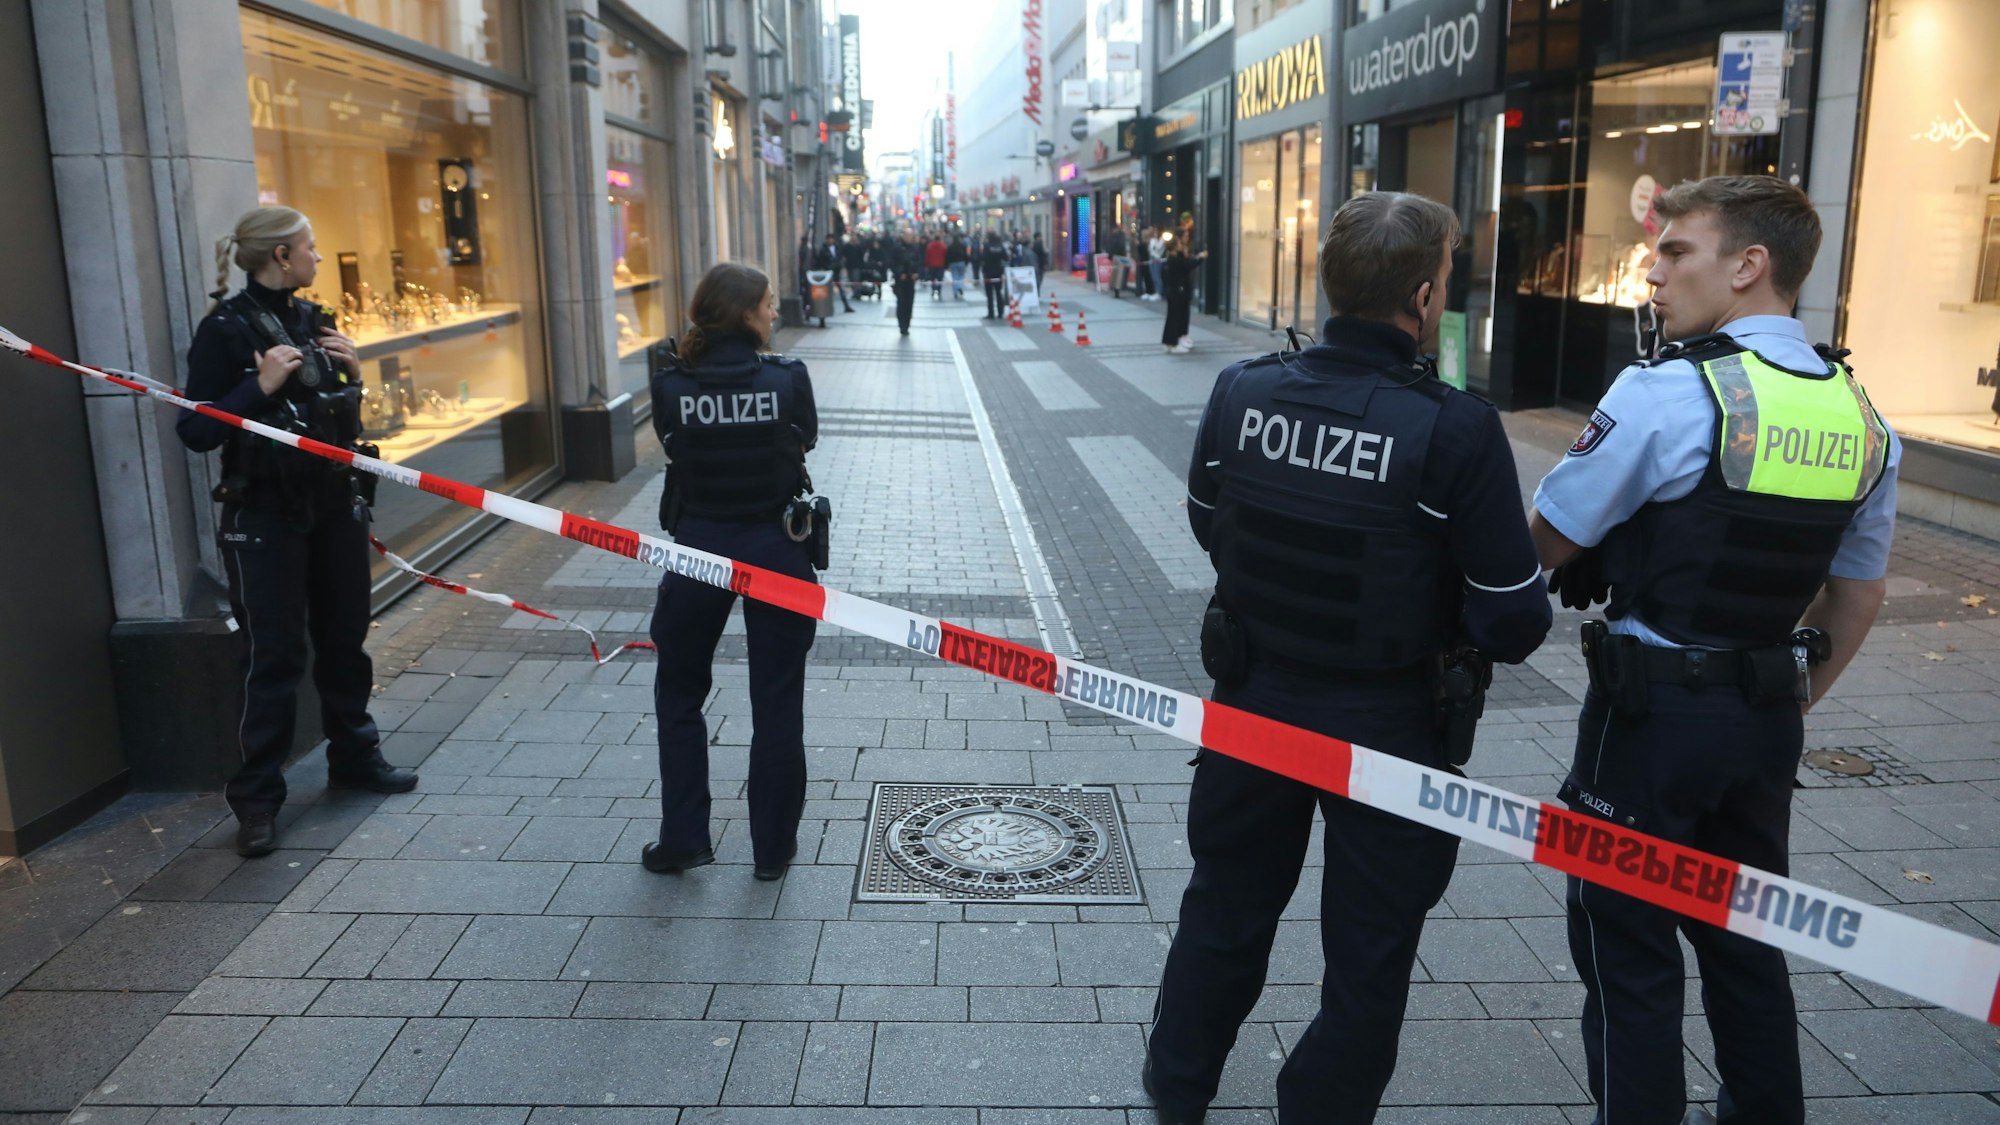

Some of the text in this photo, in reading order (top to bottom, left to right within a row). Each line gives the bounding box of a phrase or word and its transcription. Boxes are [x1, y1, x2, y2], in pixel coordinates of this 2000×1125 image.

[1237, 33, 1326, 121] RIMOWA
[1350, 13, 1480, 77] waterdrop
[1023, 56, 1042, 126] Media
[680, 391, 779, 425] POLIZEI
[1238, 407, 1395, 483] POLIZEI
[1763, 425, 1859, 471] POLIZEI
[1579, 790, 1614, 817] POLIZEI
